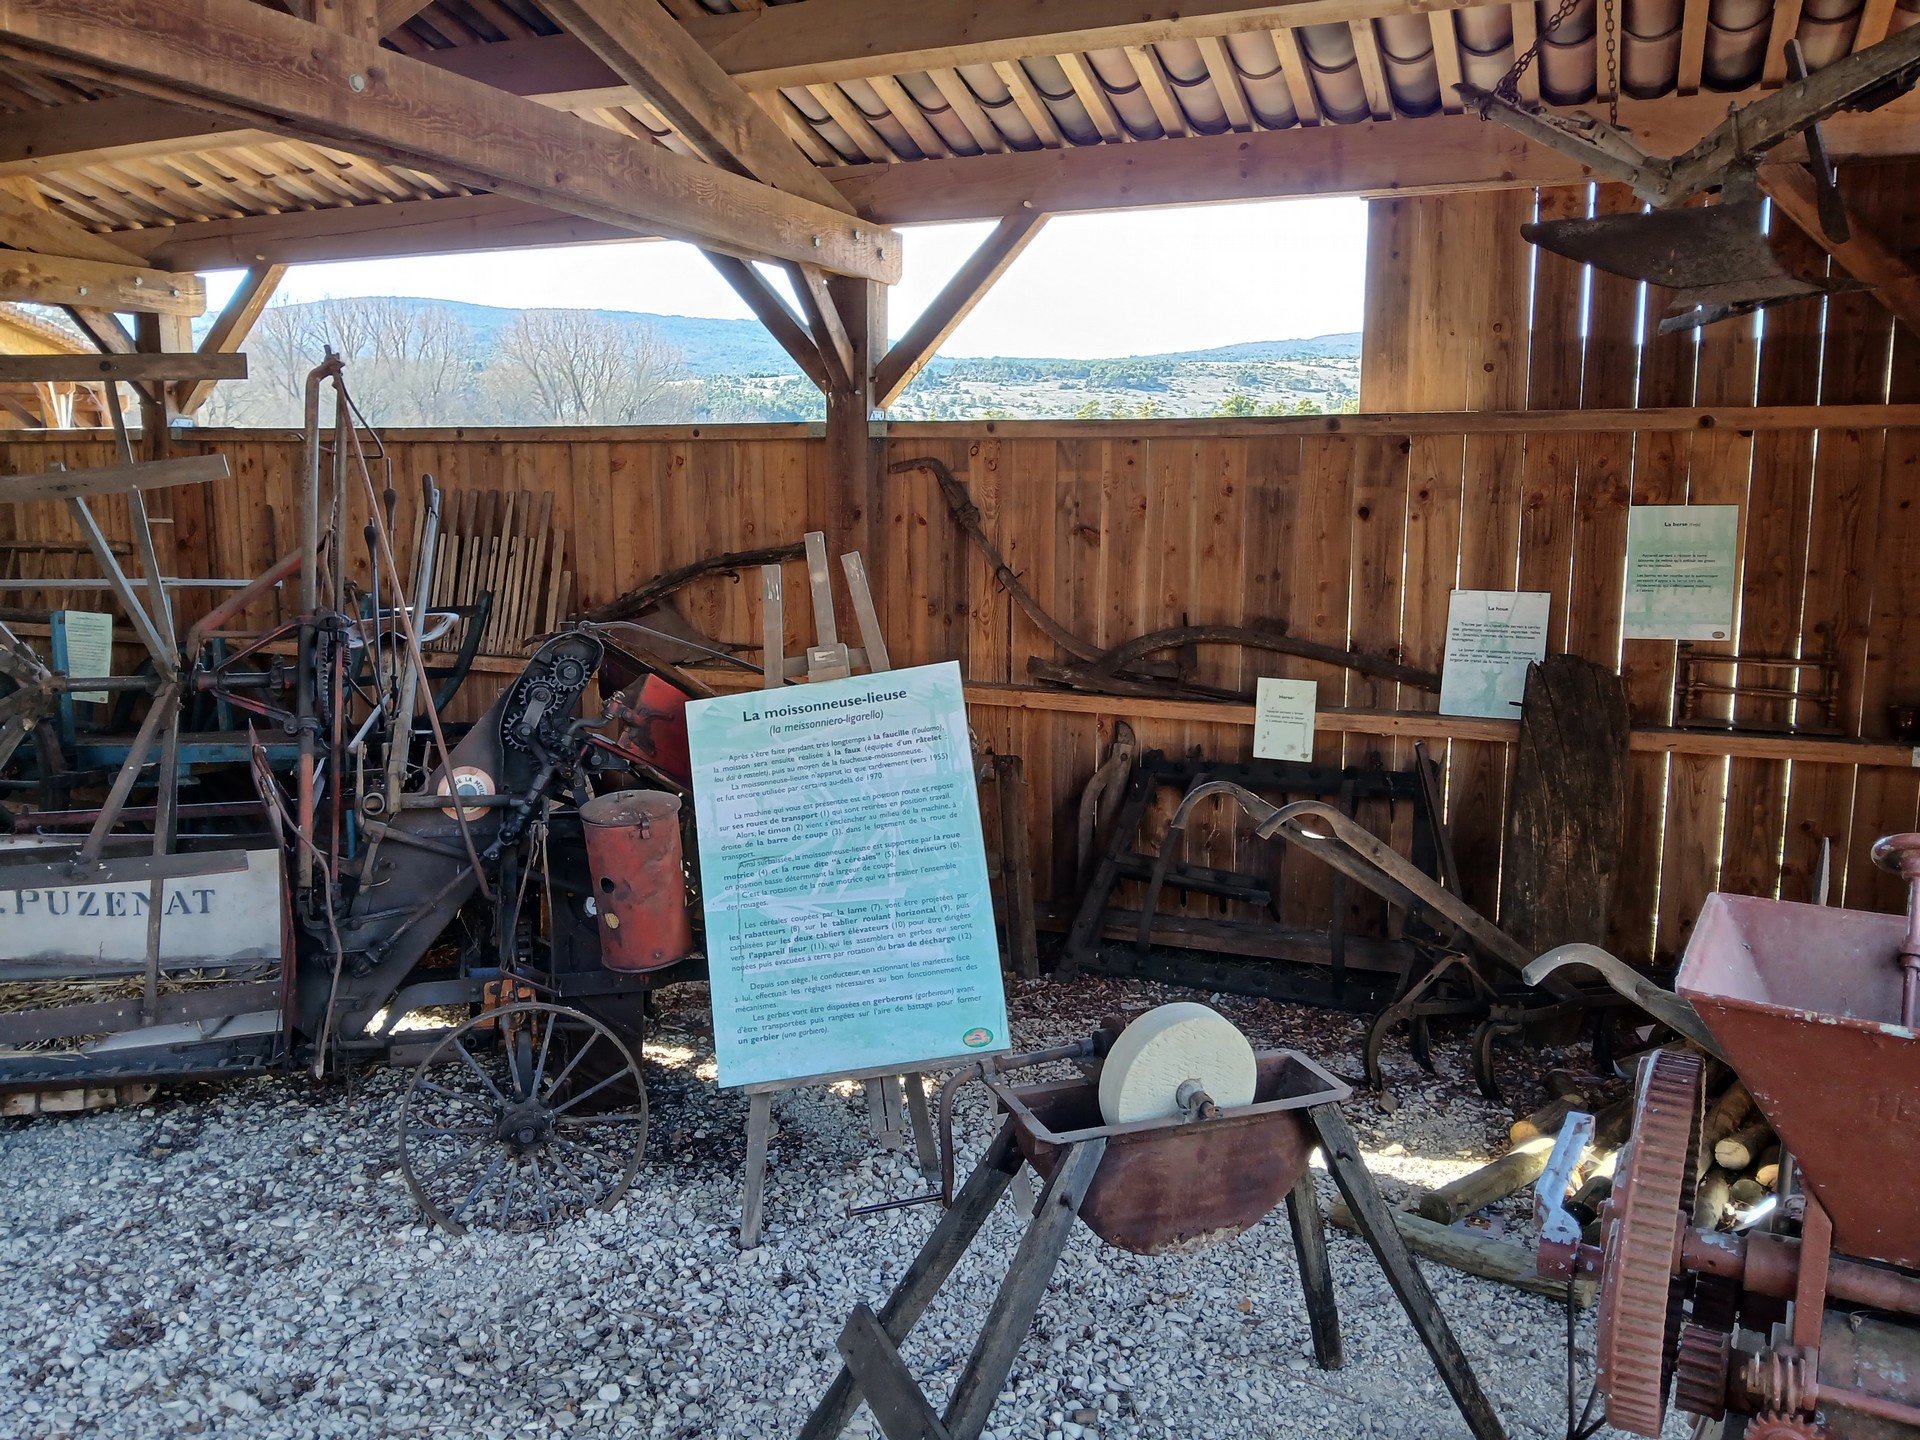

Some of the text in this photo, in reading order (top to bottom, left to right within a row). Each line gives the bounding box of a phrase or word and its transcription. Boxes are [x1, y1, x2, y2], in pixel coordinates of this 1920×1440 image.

[743, 689, 907, 721] La moissonneuse-lieuse
[769, 708, 884, 735] (la meissonniero-ligarello)
[722, 763, 750, 771] moisson
[771, 756, 794, 764] ensuite
[798, 751, 825, 760] réalisée
[864, 741, 893, 752] (équipée
[915, 734, 942, 743] râtelet
[729, 753, 748, 762] Après
[787, 743, 814, 754] pendant
[831, 736, 866, 746] longtemps
[882, 729, 909, 738] faucille
[741, 774, 809, 788] moissonneuse-lieuse
[811, 769, 842, 778] n'apparut
[868, 759, 909, 770] tardivement
[930, 752, 948, 760] 1955)
[772, 767, 785, 775] puis
[737, 791, 760, 799] encore
[762, 787, 785, 795] utilisée
[801, 781, 827, 789] certains
[829, 776, 853, 785] au-delà
[744, 809, 771, 817] machine
[773, 806, 784, 815] qui
[815, 797, 848, 808] présentée
[872, 790, 899, 800] position
[768, 826, 791, 834] timon
[825, 815, 866, 826] s'enclencher
[879, 810, 899, 818] milieu
[781, 812, 818, 822] transport
[820, 809, 829, 818] (1)
[861, 802, 887, 810] retirées
[900, 796, 927, 806] position
[721, 843, 742, 851] droite
[802, 831, 828, 839] coupe
[874, 819, 905, 829] logement
[802, 845, 870, 859] moissonneuse-lieuse
[884, 837, 919, 847] supportée
[724, 872, 754, 880] motrice
[912, 844, 946, 853] diviseurs
[735, 880, 762, 890] position
[785, 871, 826, 882] déterminant
[835, 866, 861, 874] largeur
[741, 890, 760, 898] C'est
[770, 886, 797, 894] rotation
[835, 876, 863, 884] motrice
[865, 873, 875, 882] qui
[920, 862, 956, 872] l'ensemble
[744, 928, 785, 938] rabatteurs
[790, 924, 802, 933] (8)
[832, 918, 858, 926] tablier
[862, 913, 890, 922] roulant
[895, 905, 937, 917] horizontal
[956, 901, 969, 910] puis
[759, 917, 787, 926] céréales
[791, 913, 821, 921] coupées
[921, 894, 953, 904] projetées
[816, 930, 845, 939] tabliers
[848, 924, 889, 934] élévateurs
[892, 920, 905, 929] (10)
[908, 919, 925, 927] pour
[944, 912, 971, 921] dirigées
[749, 948, 785, 958] l'appareil
[856, 934, 894, 943] assemblera
[909, 928, 934, 937] gerbes
[936, 925, 946, 934] qui
[950, 922, 972, 930] seront
[758, 960, 772, 969] puis
[775, 956, 805, 965] évacuées
[847, 947, 875, 955] rotation
[919, 936, 955, 945] décharge
[750, 981, 774, 990] Depuis
[872, 962, 908, 972] actionnant
[756, 989, 786, 999] effectuait
[804, 984, 832, 993] réglages
[835, 978, 874, 988] nécessaires
[907, 965, 962, 978] fonctionnement
[762, 1019, 806, 1030] transportées
[810, 1016, 824, 1025] puis
[828, 1012, 854, 1021] rangées
[907, 1002, 935, 1010] battage
[936, 999, 953, 1007] pour
[957, 995, 982, 1003] former
[767, 1011, 789, 1020] gerbes
[826, 1001, 859, 1011] disposées
[873, 994, 912, 1005] gerberons
[750, 1033, 779, 1043] gerbier
